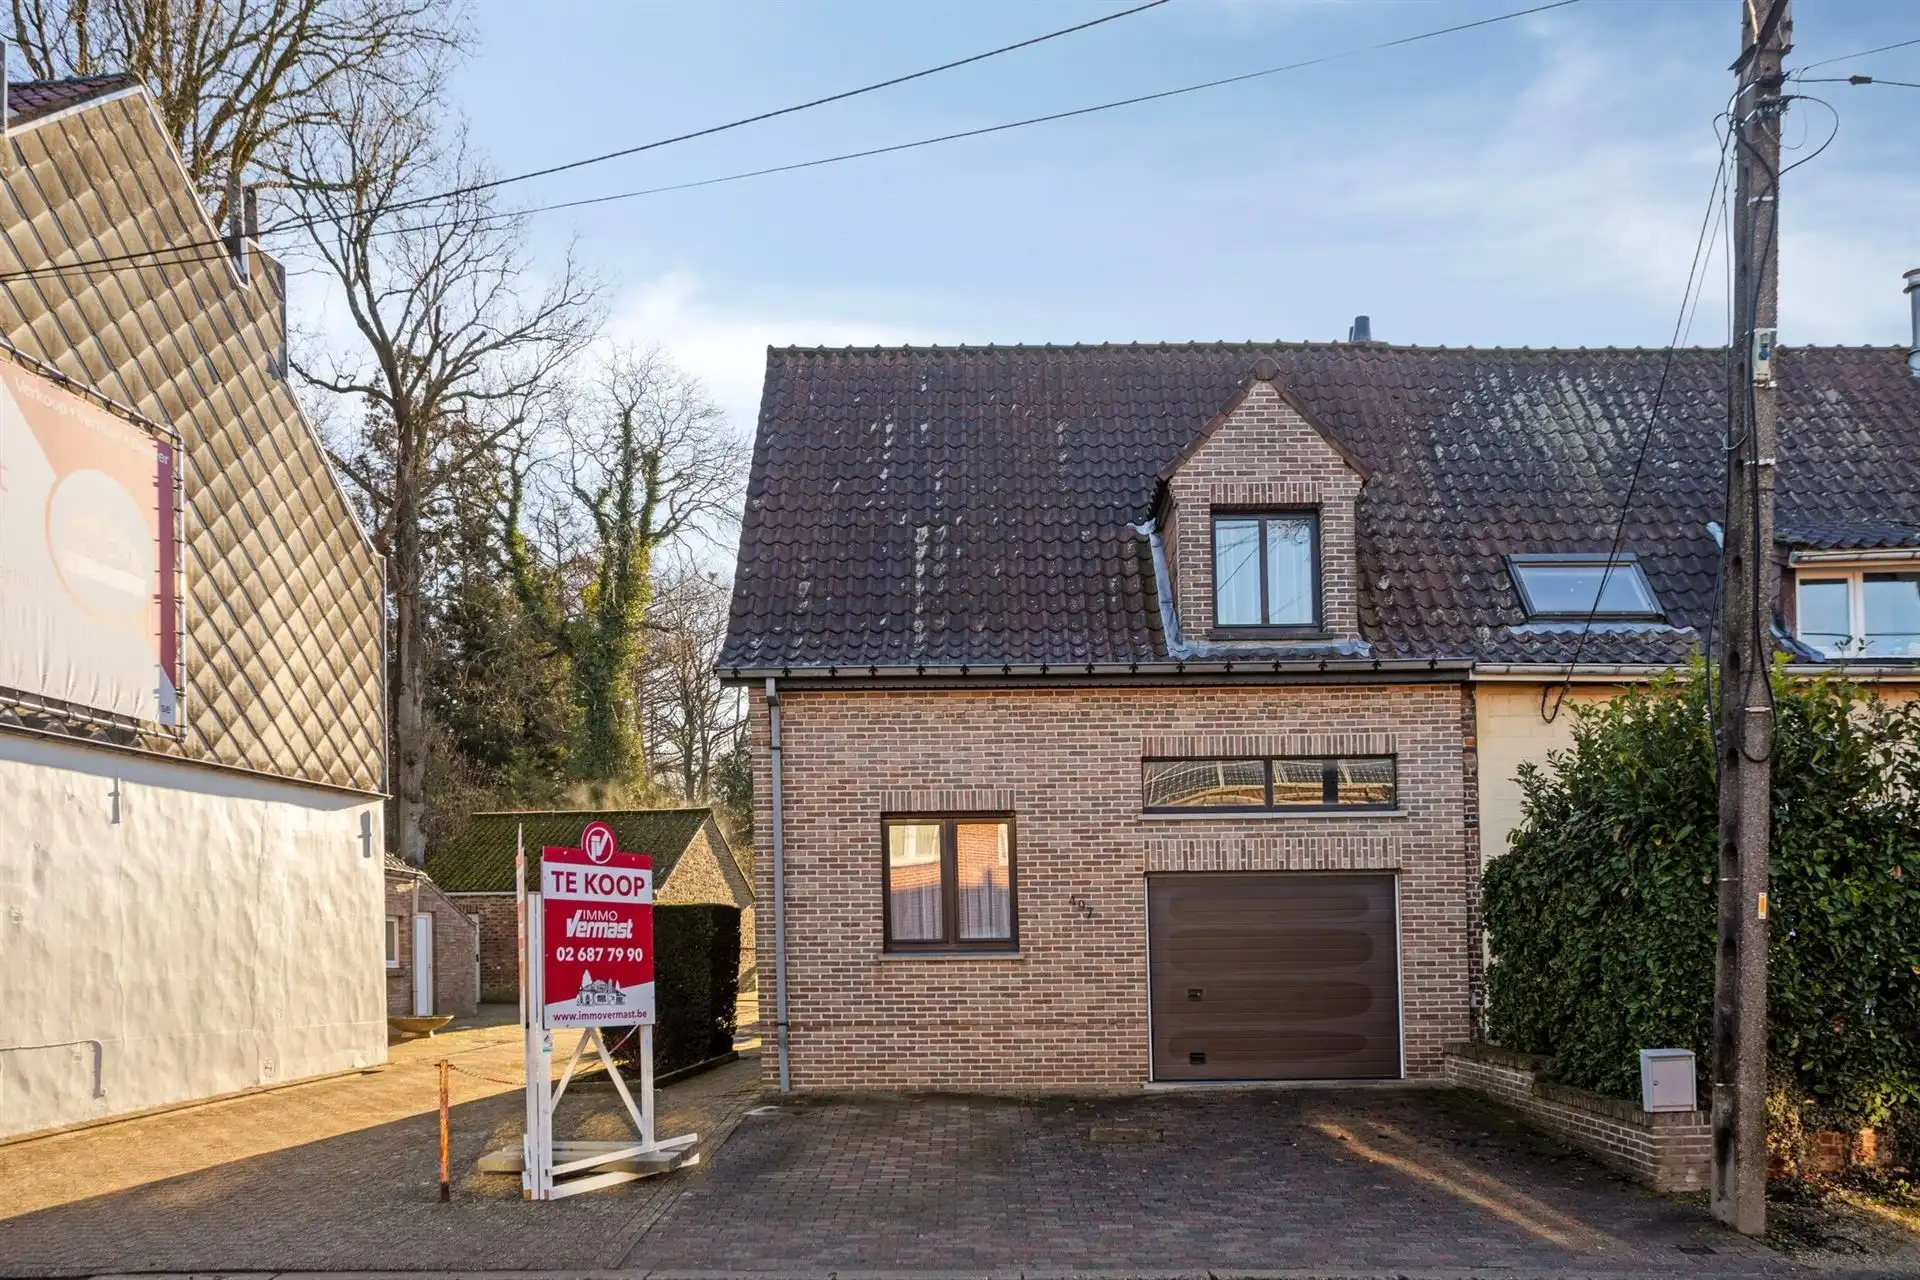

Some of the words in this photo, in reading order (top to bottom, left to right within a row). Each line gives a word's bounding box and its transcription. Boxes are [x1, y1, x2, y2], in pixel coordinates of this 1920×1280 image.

[551, 870, 577, 893] TE
[584, 873, 645, 897] KOOP
[583, 910, 618, 921] IMMO
[566, 909, 633, 939] Vermast
[556, 946, 574, 962] 02
[577, 946, 604, 962] 687
[607, 947, 624, 962] 79
[626, 947, 643, 962] 90
[552, 1009, 648, 1021] www.immovermast.be
